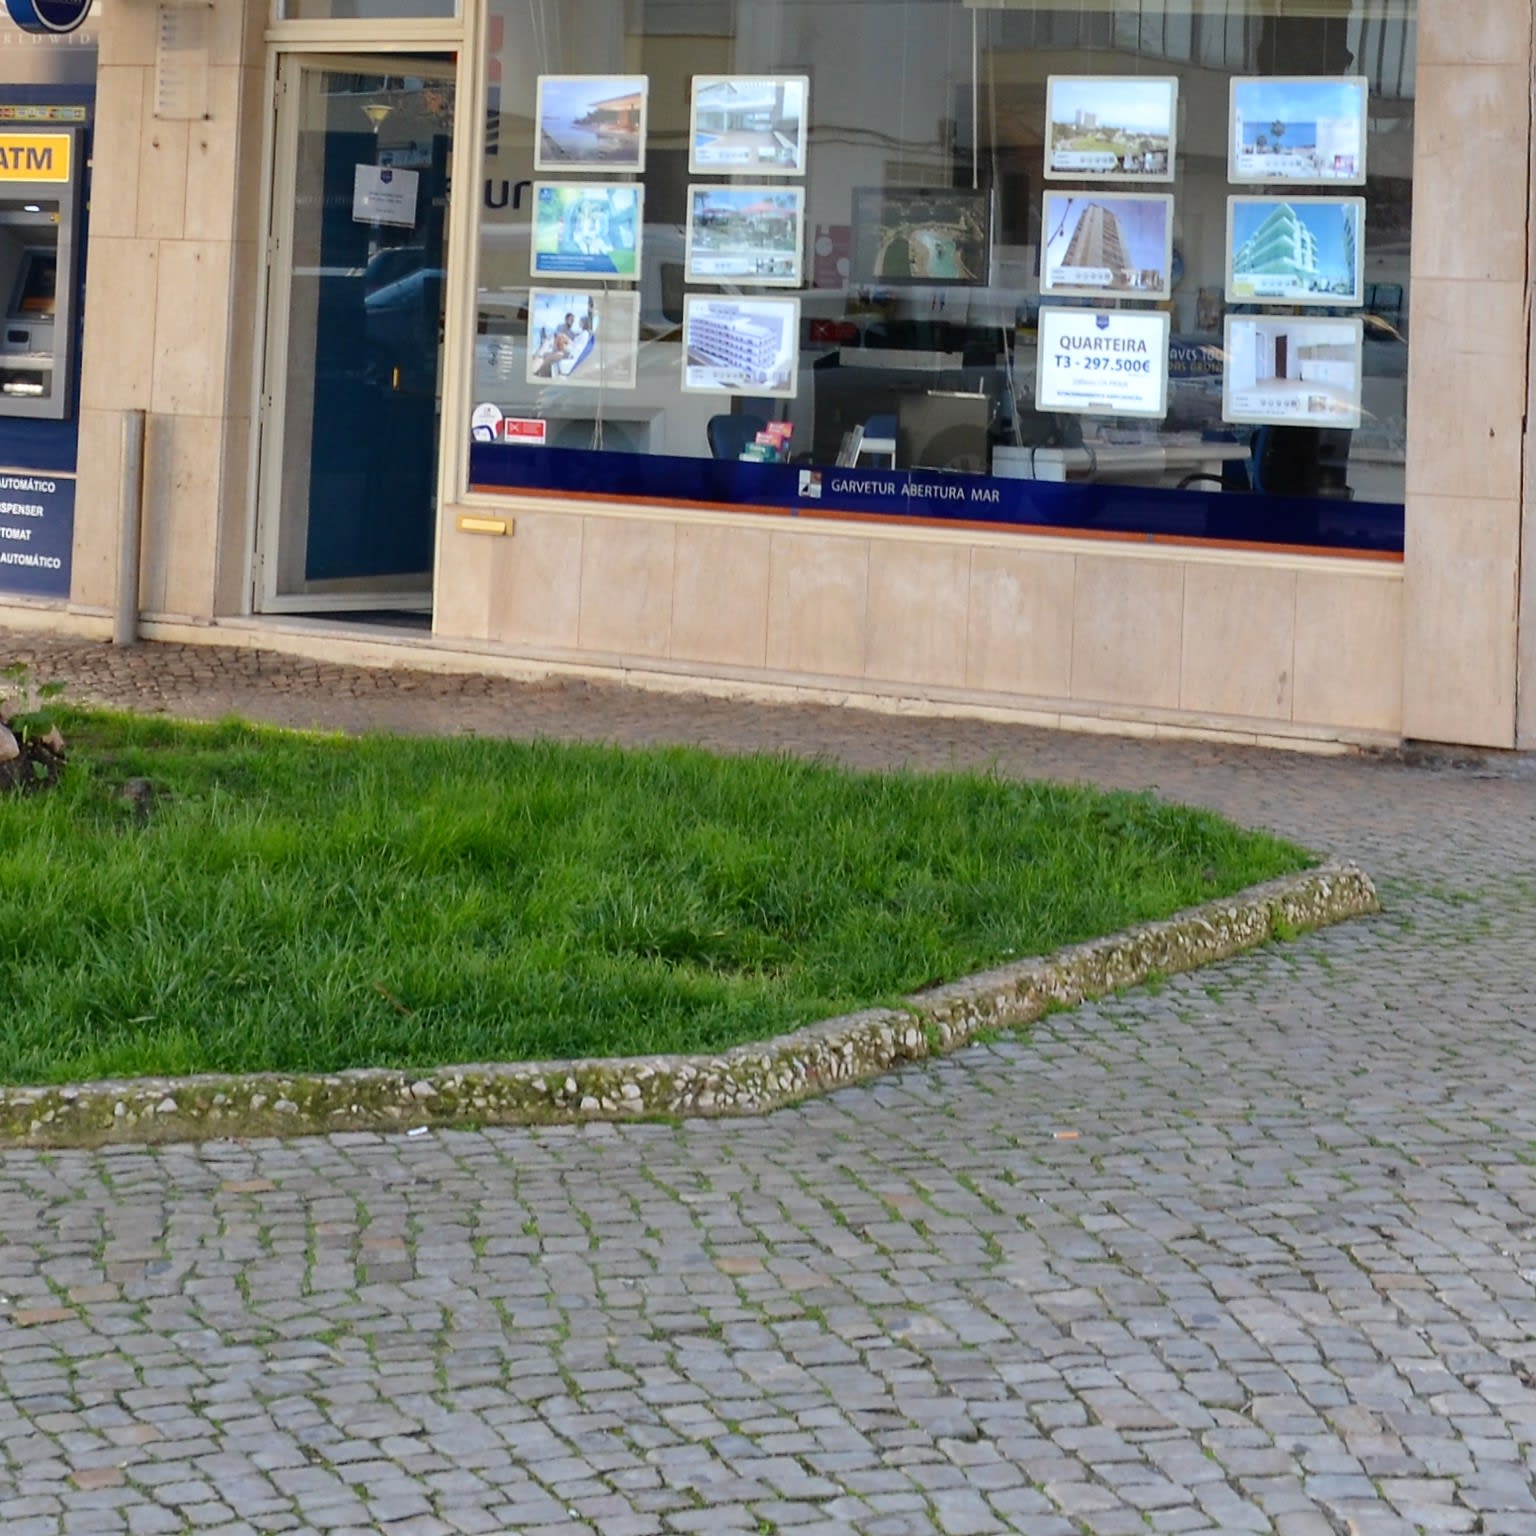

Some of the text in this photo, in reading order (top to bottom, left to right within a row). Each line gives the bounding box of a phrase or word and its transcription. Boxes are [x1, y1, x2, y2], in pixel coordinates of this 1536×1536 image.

[1059, 335, 1147, 353] QUARTEIRA
[1054, 354, 1072, 369] T3
[1083, 356, 1151, 374] 297.500€
[830, 478, 1001, 503] GARVETUR ABERTURA MAR
[0, 552, 61, 569] AUTOMÁTICO
